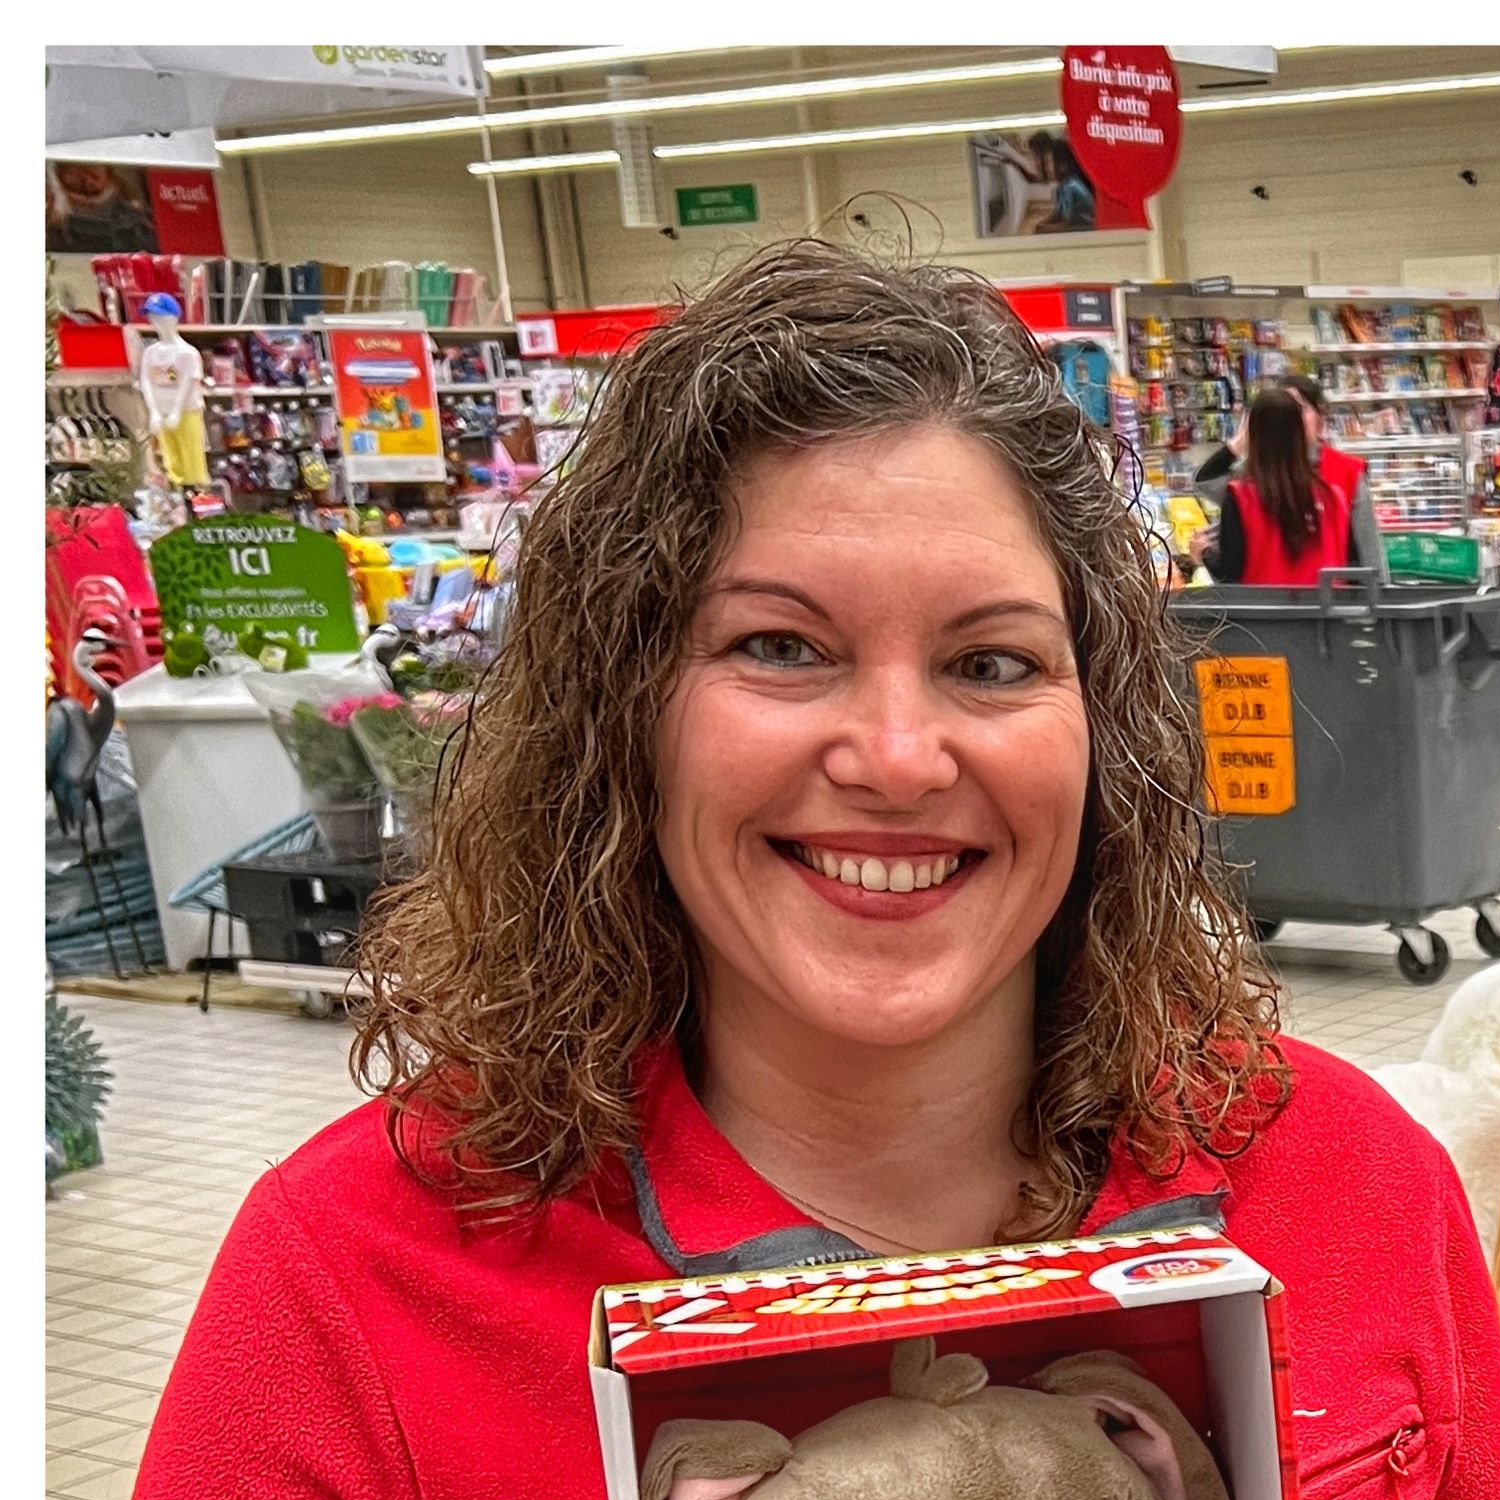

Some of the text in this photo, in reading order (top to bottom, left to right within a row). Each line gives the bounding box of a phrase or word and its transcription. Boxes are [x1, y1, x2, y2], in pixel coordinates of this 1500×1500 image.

[342, 45, 448, 66] gardenstar
[193, 526, 297, 543] RETROUVEZ
[229, 547, 271, 575] ICI
